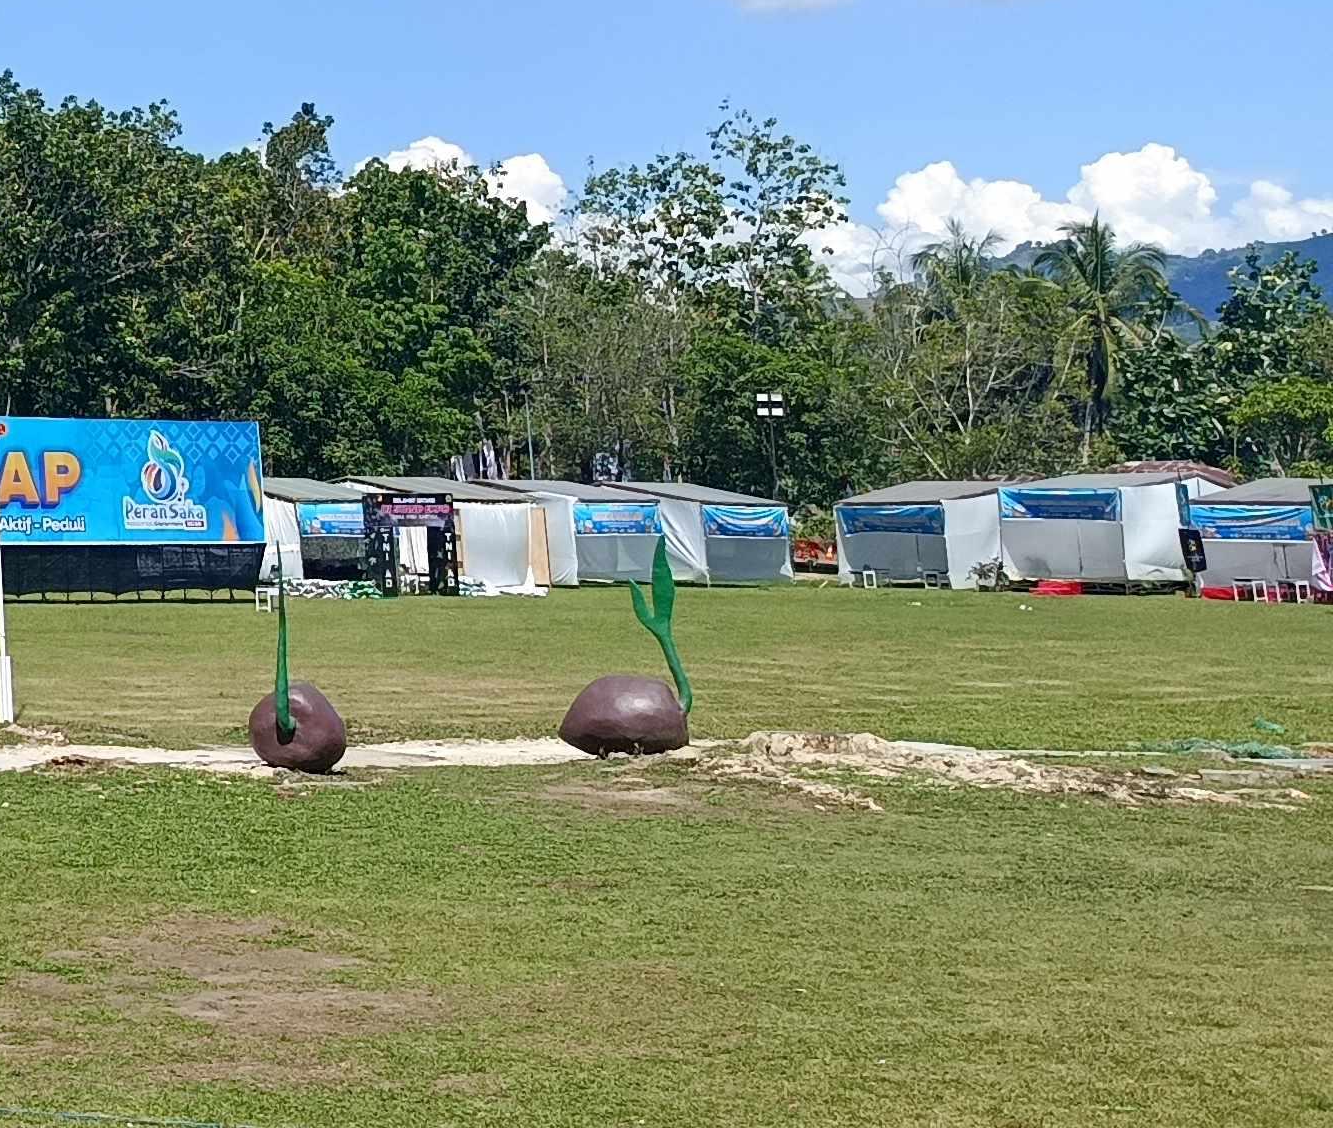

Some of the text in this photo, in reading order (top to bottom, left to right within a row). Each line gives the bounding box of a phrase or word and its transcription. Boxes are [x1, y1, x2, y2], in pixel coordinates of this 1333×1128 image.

[0, 516, 32, 535] Aktif
[42, 516, 86, 532] Peduli
[125, 501, 167, 520] Peran
[382, 533, 393, 588] TNI AD
[445, 532, 455, 587] TNI AD
